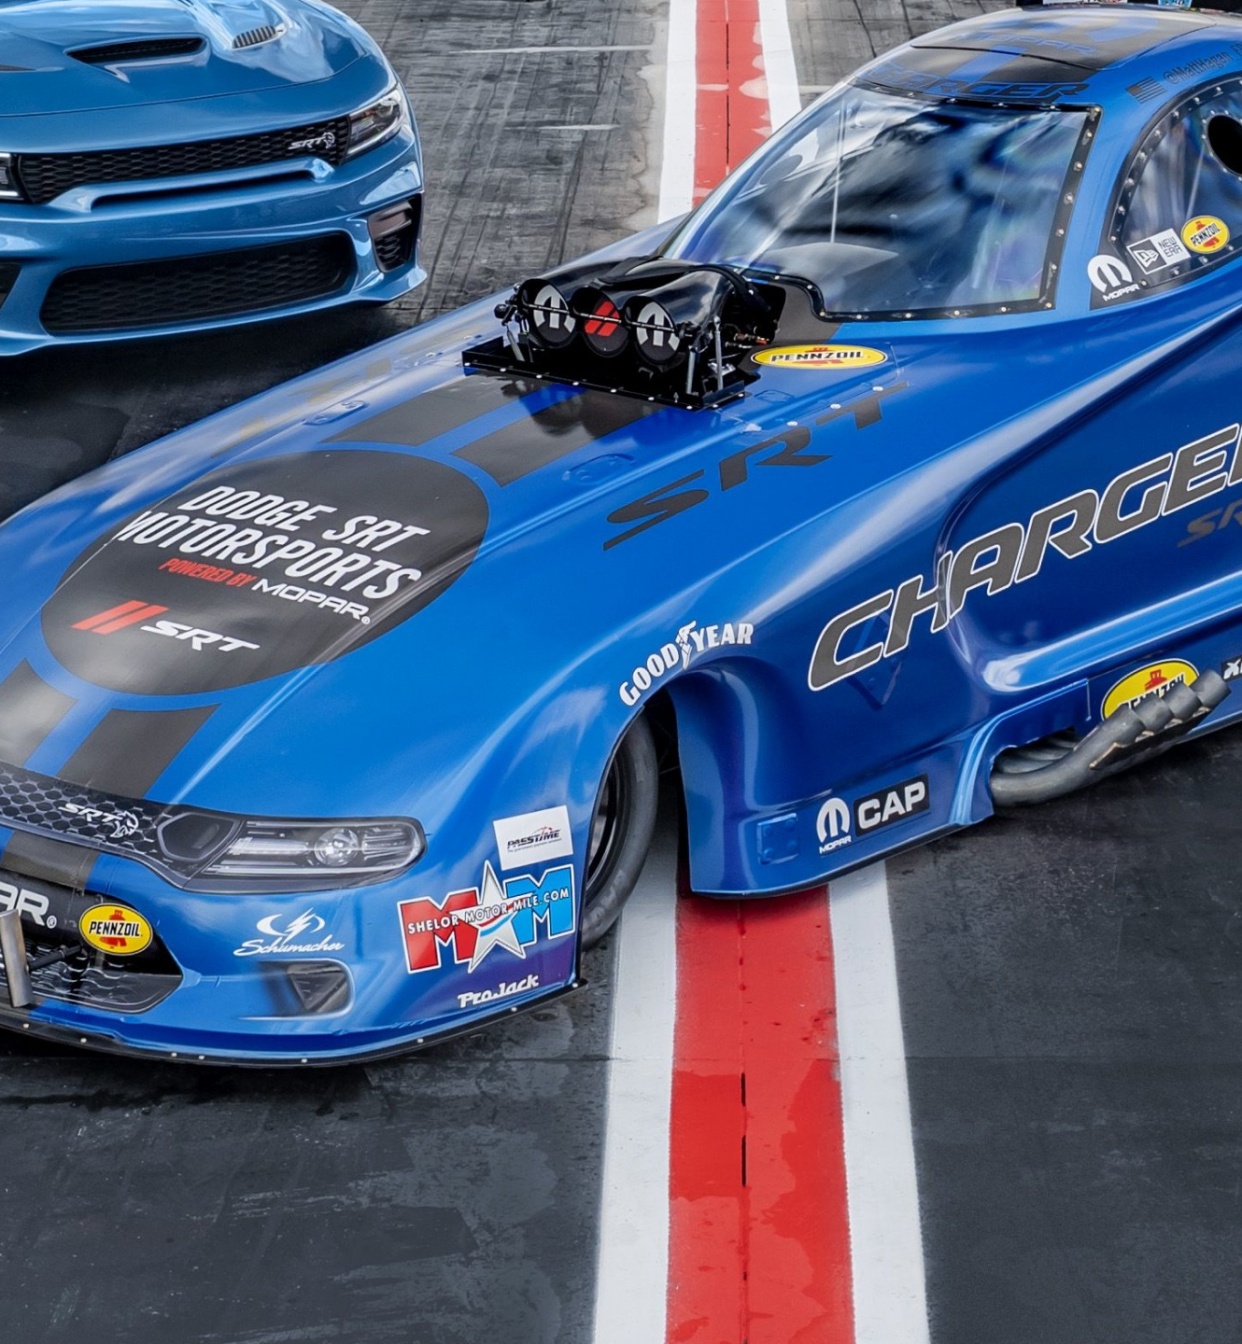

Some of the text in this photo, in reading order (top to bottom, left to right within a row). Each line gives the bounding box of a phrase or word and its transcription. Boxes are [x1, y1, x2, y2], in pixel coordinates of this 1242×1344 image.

[288, 136, 326, 150] SRT
[1158, 236, 1177, 249] NEW
[1190, 223, 1222, 247] PENNZOIL
[1164, 246, 1183, 257] ERA
[1102, 283, 1140, 302] MOPAR
[771, 350, 862, 362] PENNZOIL
[603, 381, 909, 551] SRT
[177, 486, 430, 552] DODGE SRT
[117, 511, 422, 599] MOTORSPORTS
[808, 423, 1242, 692] CHARGE
[158, 558, 235, 584] POWERED
[226, 572, 258, 588] BY
[140, 620, 260, 652] SRT
[619, 621, 753, 706] GOODYEAR
[58, 803, 123, 823] SRT
[857, 780, 926, 830] CAP
[819, 836, 852, 855] MOPAR
[408, 888, 569, 935] SHELOR MOTOR MILE.COM
[89, 920, 141, 937] PENNZOIL
[233, 938, 345, 957] Schumacher
[457, 974, 539, 1008] ProJack
